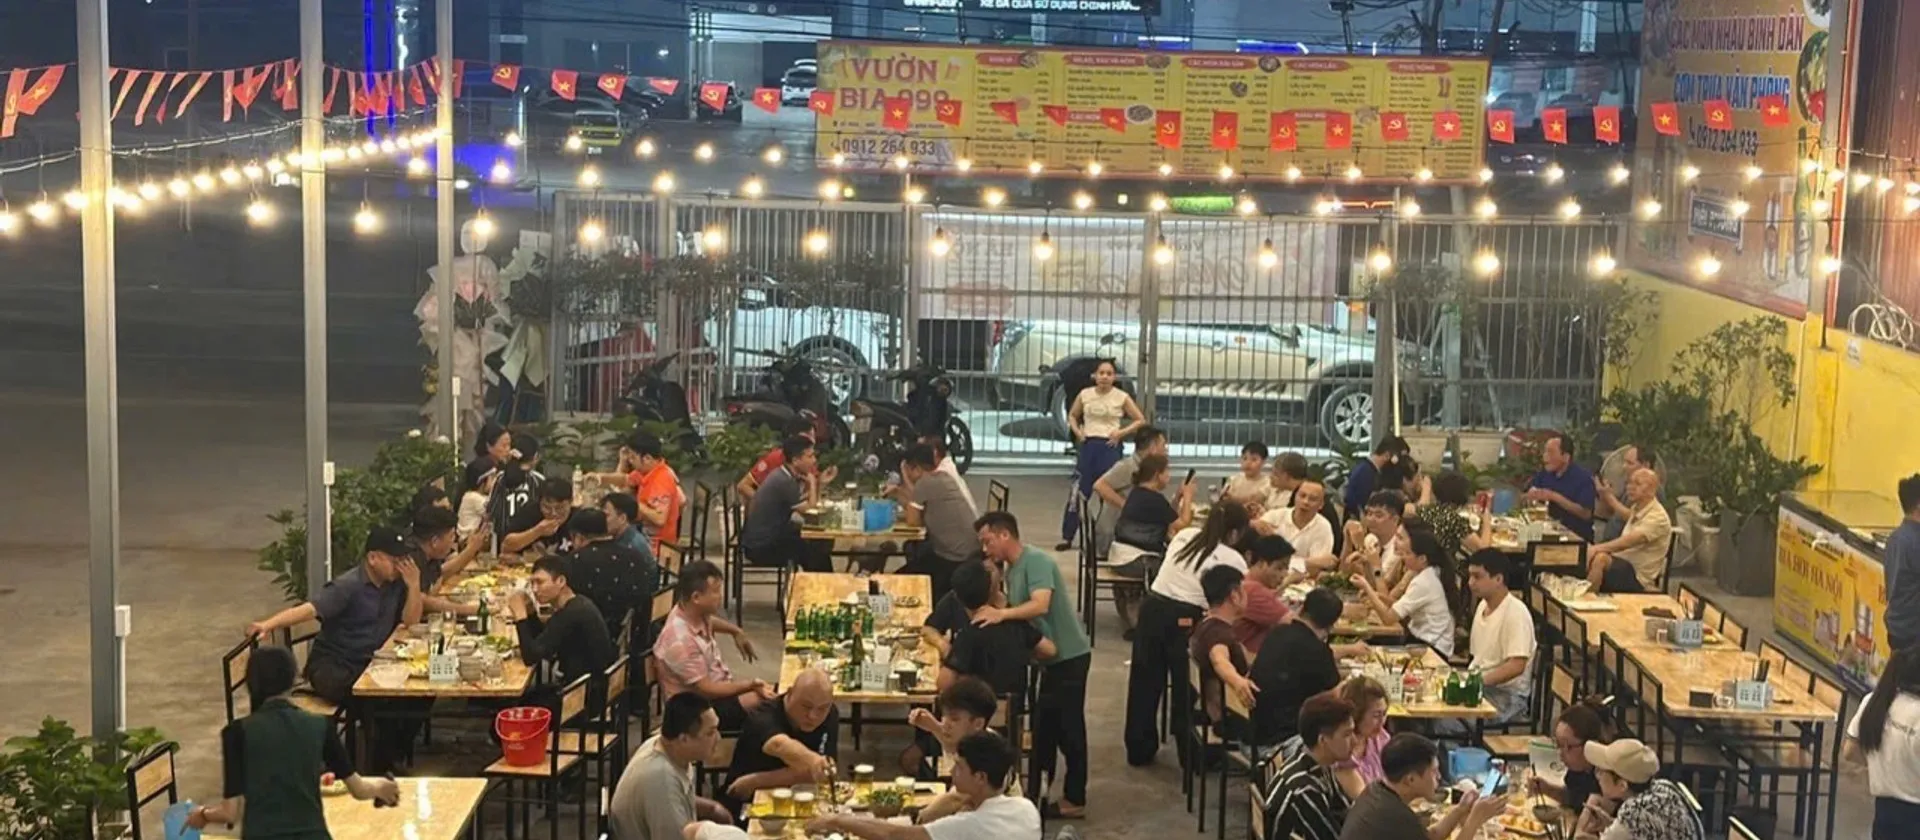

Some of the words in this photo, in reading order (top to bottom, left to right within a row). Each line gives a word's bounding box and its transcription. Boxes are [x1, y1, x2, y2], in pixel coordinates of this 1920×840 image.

[851, 52, 938, 84] VƯỜN
[840, 87, 886, 111] BIA
[842, 138, 876, 154] 0912
[880, 139, 905, 155] 264
[910, 140, 936, 155] 933
